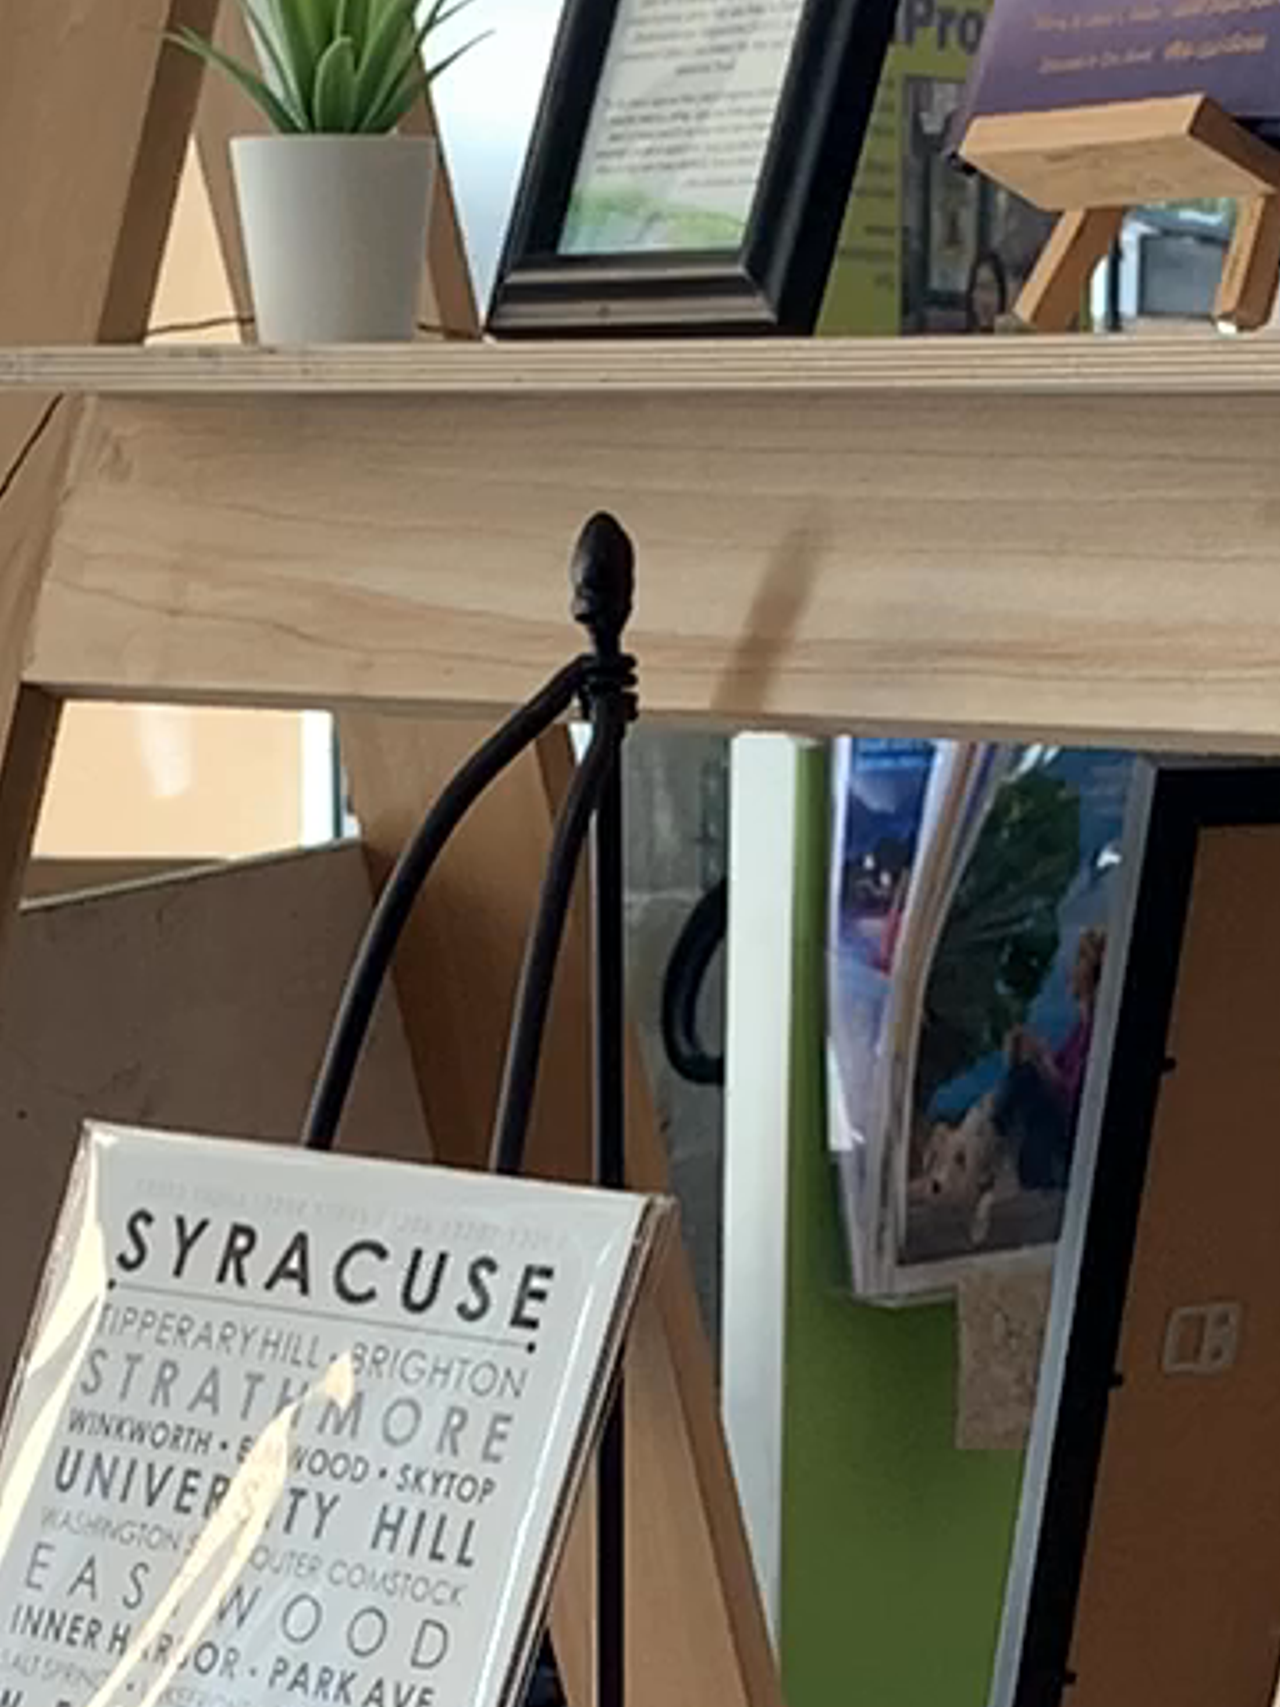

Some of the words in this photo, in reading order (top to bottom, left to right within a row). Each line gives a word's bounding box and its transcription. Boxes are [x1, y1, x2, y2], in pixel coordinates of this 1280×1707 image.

[116, 1208, 555, 1330] SYRACUSE
[79, 1348, 515, 1462] STRATHMORE
[260, 1329, 325, 1370] HILL
[351, 1342, 529, 1400] BRIGHTON
[68, 1407, 212, 1456] WINKWORTH
[396, 1463, 497, 1505] SKYTOP
[371, 1504, 477, 1567] HILL
[9, 1601, 100, 1653] INNER
[268, 1657, 354, 1706] PARK
